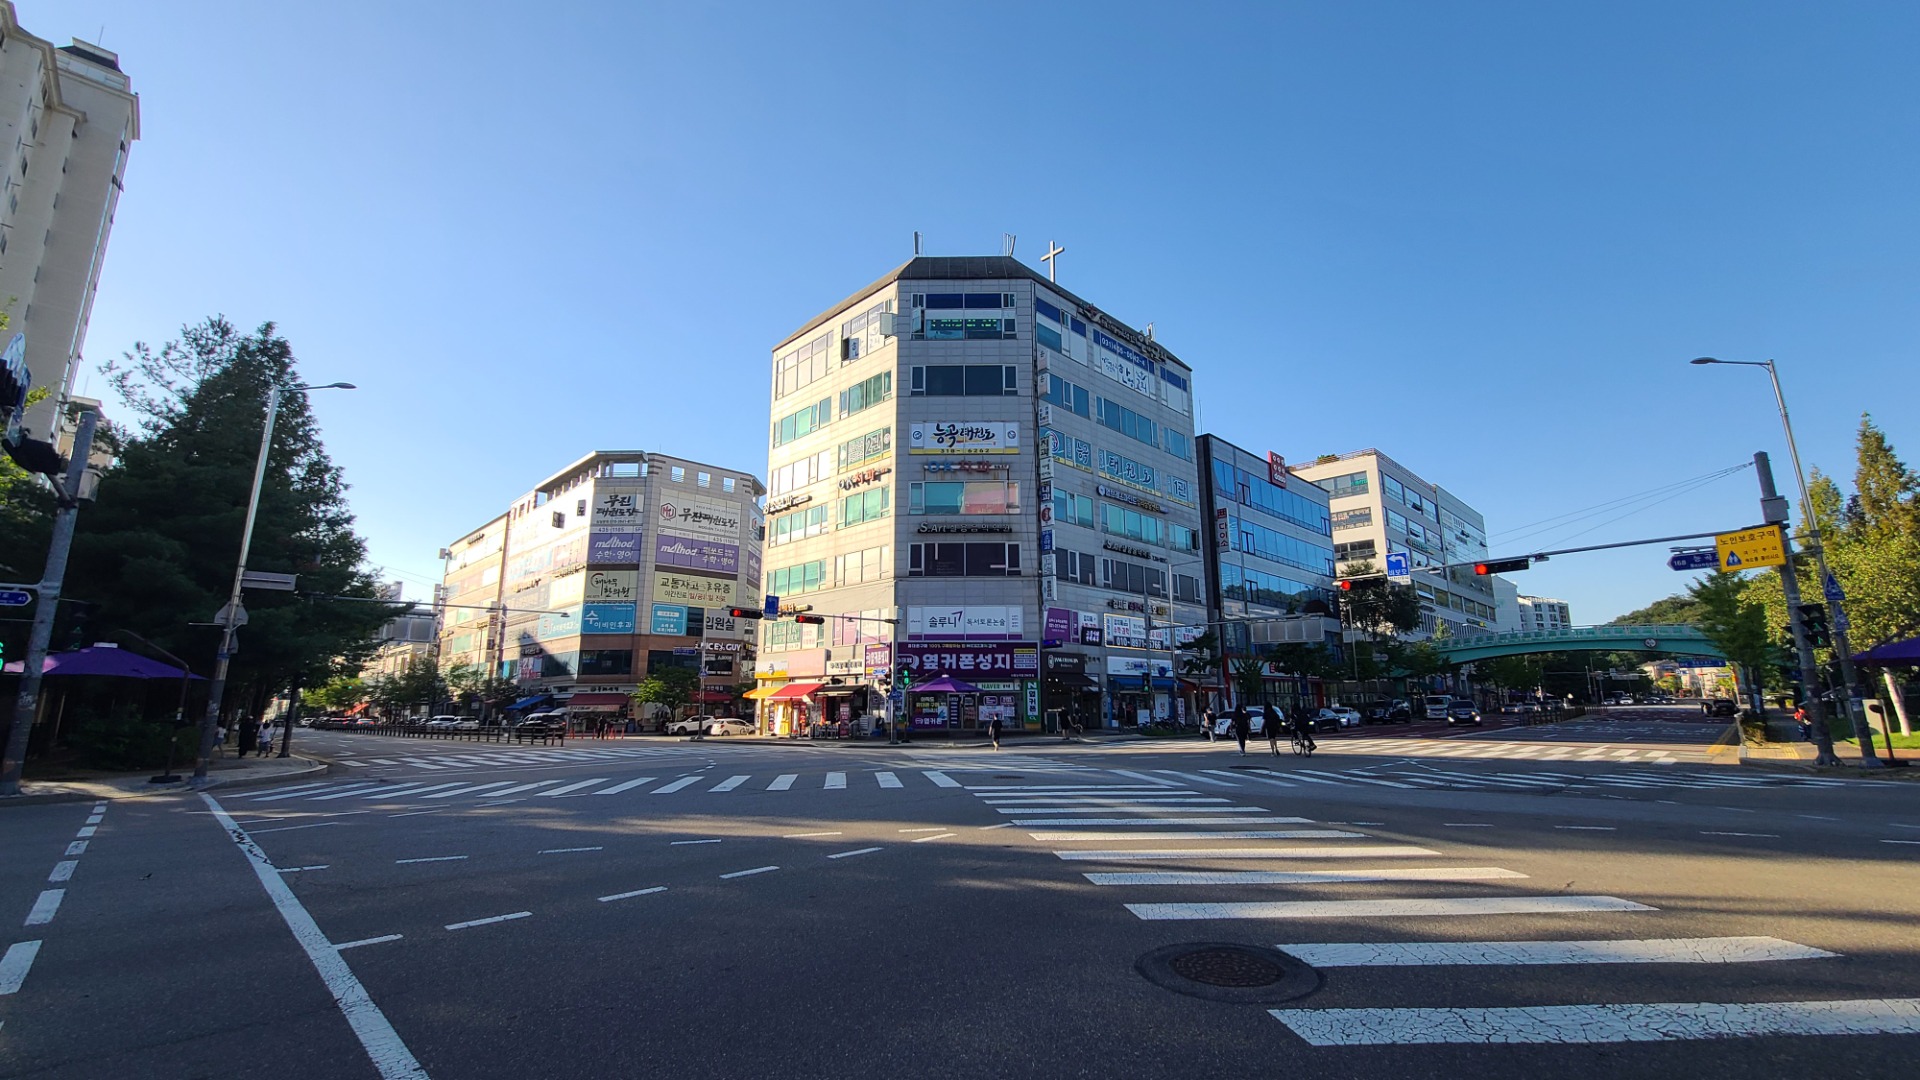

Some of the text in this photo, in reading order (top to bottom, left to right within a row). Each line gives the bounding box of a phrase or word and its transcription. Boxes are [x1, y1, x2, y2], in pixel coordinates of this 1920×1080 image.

[604, 494, 632, 507] 무진
[596, 508, 643, 517] 태권도장
[679, 508, 738, 528] 무진태권도장
[1219, 522, 1228, 546] 다이소
[1720, 530, 1776, 545] 노인보호구역
[660, 578, 699, 591] 교통사고
[706, 616, 735, 632] 입원실
[928, 616, 957, 628] 솔루니
[922, 653, 1010, 670] 옆커폰성지
